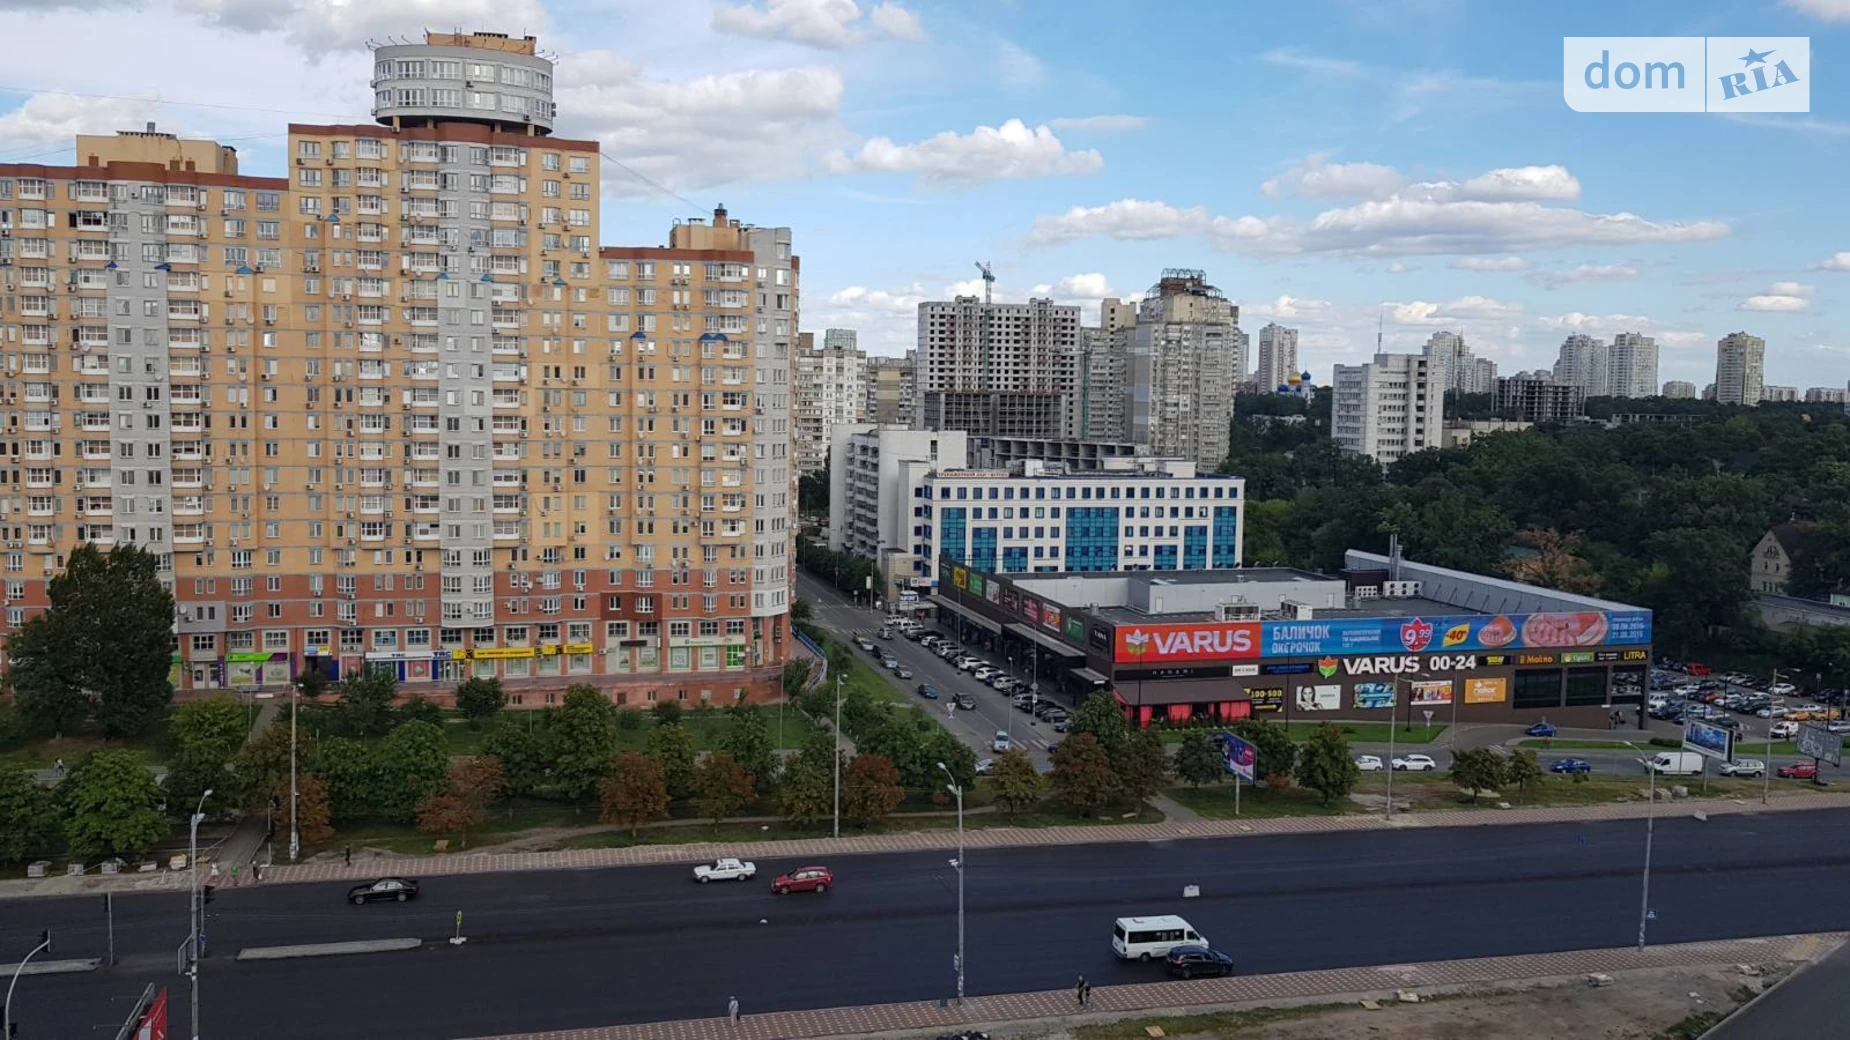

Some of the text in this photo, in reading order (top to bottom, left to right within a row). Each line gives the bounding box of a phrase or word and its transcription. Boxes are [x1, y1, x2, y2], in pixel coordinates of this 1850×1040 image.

[1272, 625, 1330, 641] БАЛИЧОК
[1153, 629, 1251, 654] VARUS
[1526, 655, 1553, 664] Molino
[1623, 651, 1647, 660] LITRA
[1343, 656, 1420, 675] VARUS
[1429, 655, 1476, 670] 00-24
